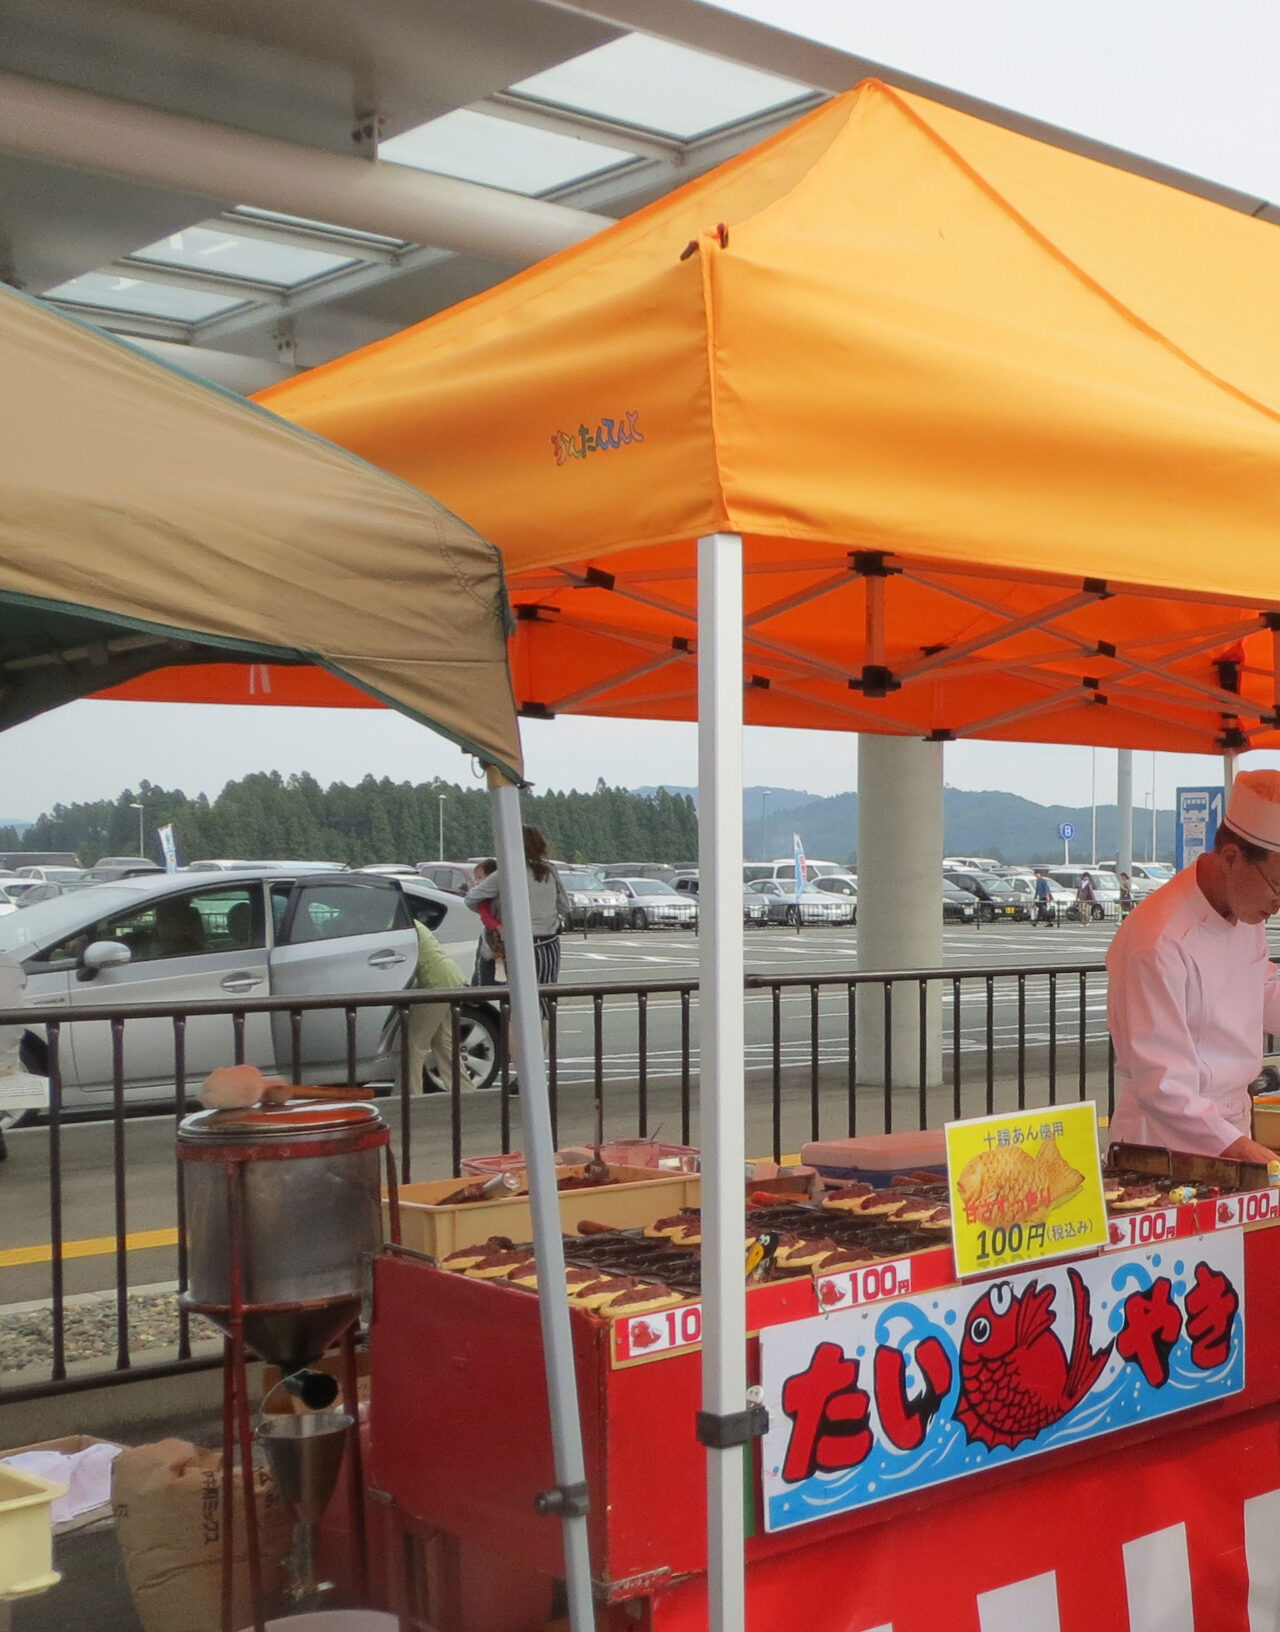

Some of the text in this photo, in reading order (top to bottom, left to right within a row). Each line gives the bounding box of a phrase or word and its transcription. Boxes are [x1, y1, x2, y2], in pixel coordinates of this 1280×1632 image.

[984, 1121, 1064, 1149] 十勝あん使用
[1238, 1192, 1279, 1223] 100円
[976, 1223, 1046, 1261] 100円
[1129, 1212, 1175, 1244] 100円
[850, 1264, 910, 1304] 100円
[781, 1260, 1240, 1483] たい やき
